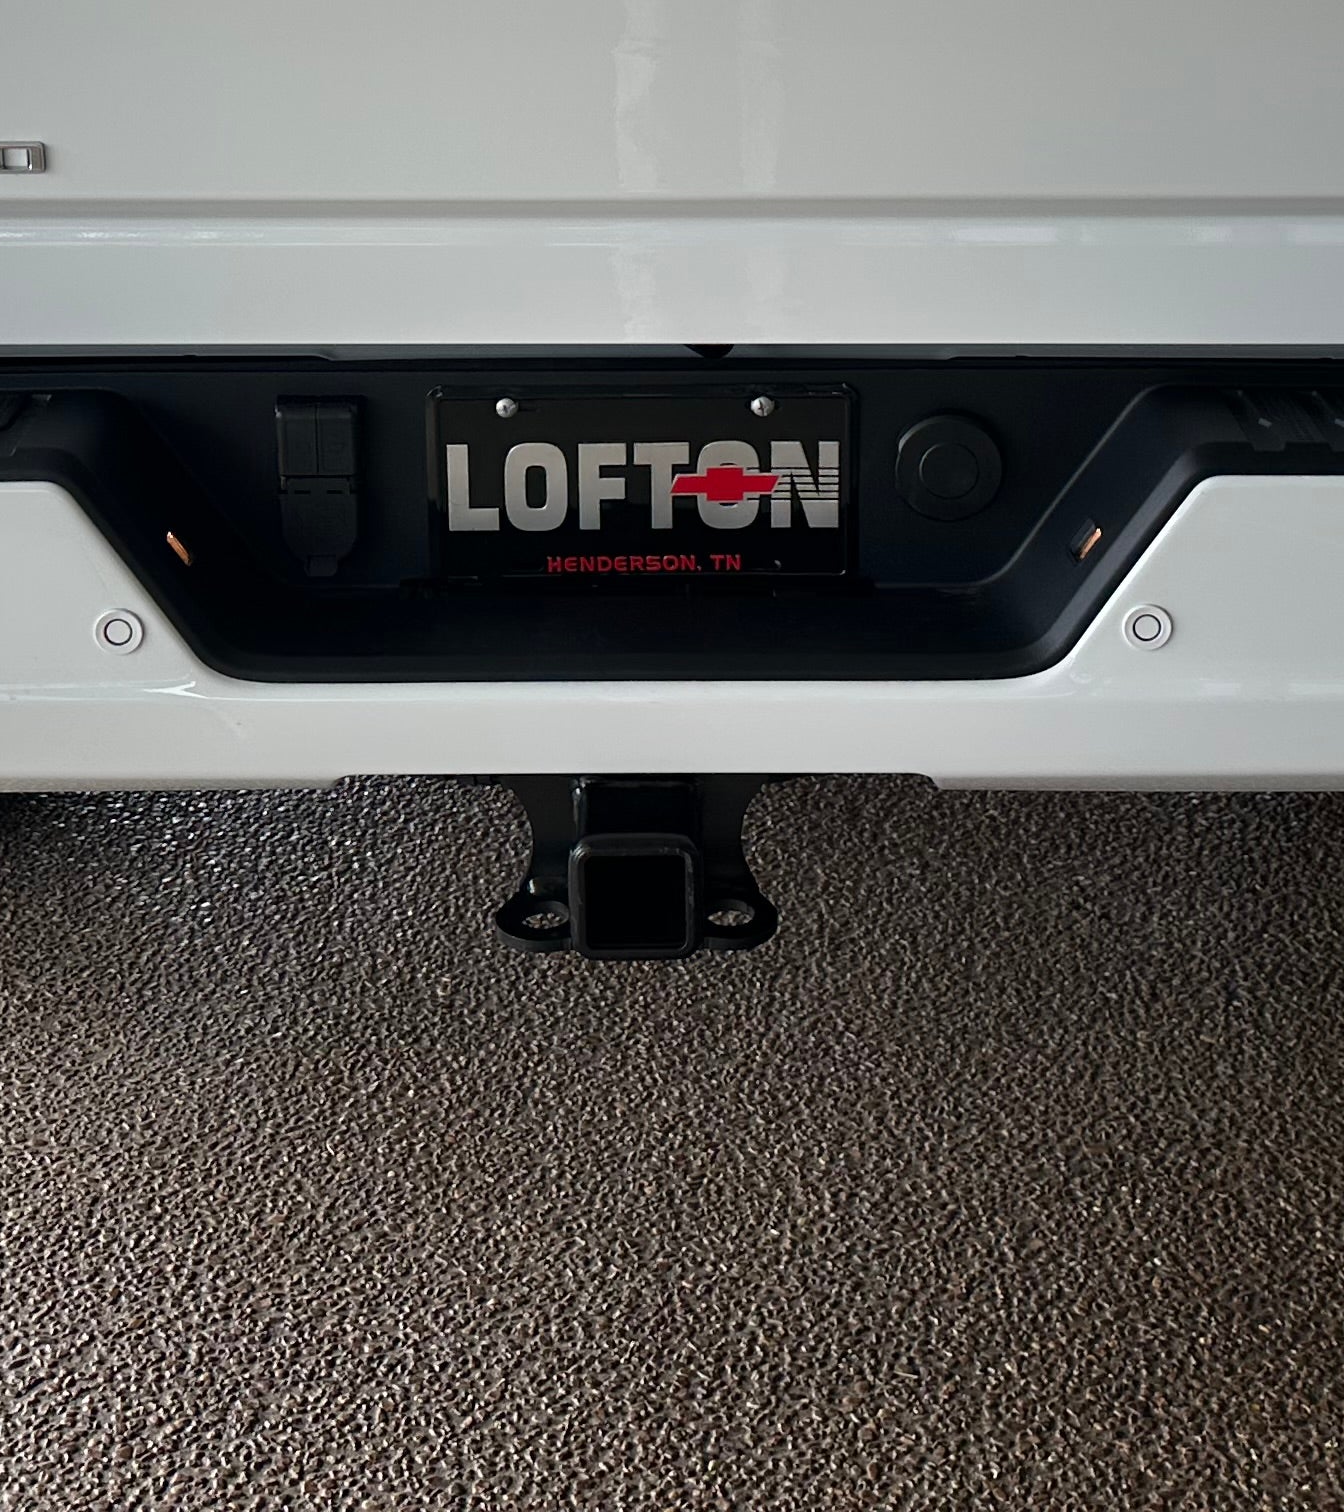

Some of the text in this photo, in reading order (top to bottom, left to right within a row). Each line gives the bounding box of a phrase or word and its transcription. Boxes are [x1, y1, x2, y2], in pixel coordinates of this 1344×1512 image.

[446, 440, 840, 531] LOFTON
[547, 554, 742, 573] HENDERSON, TN
